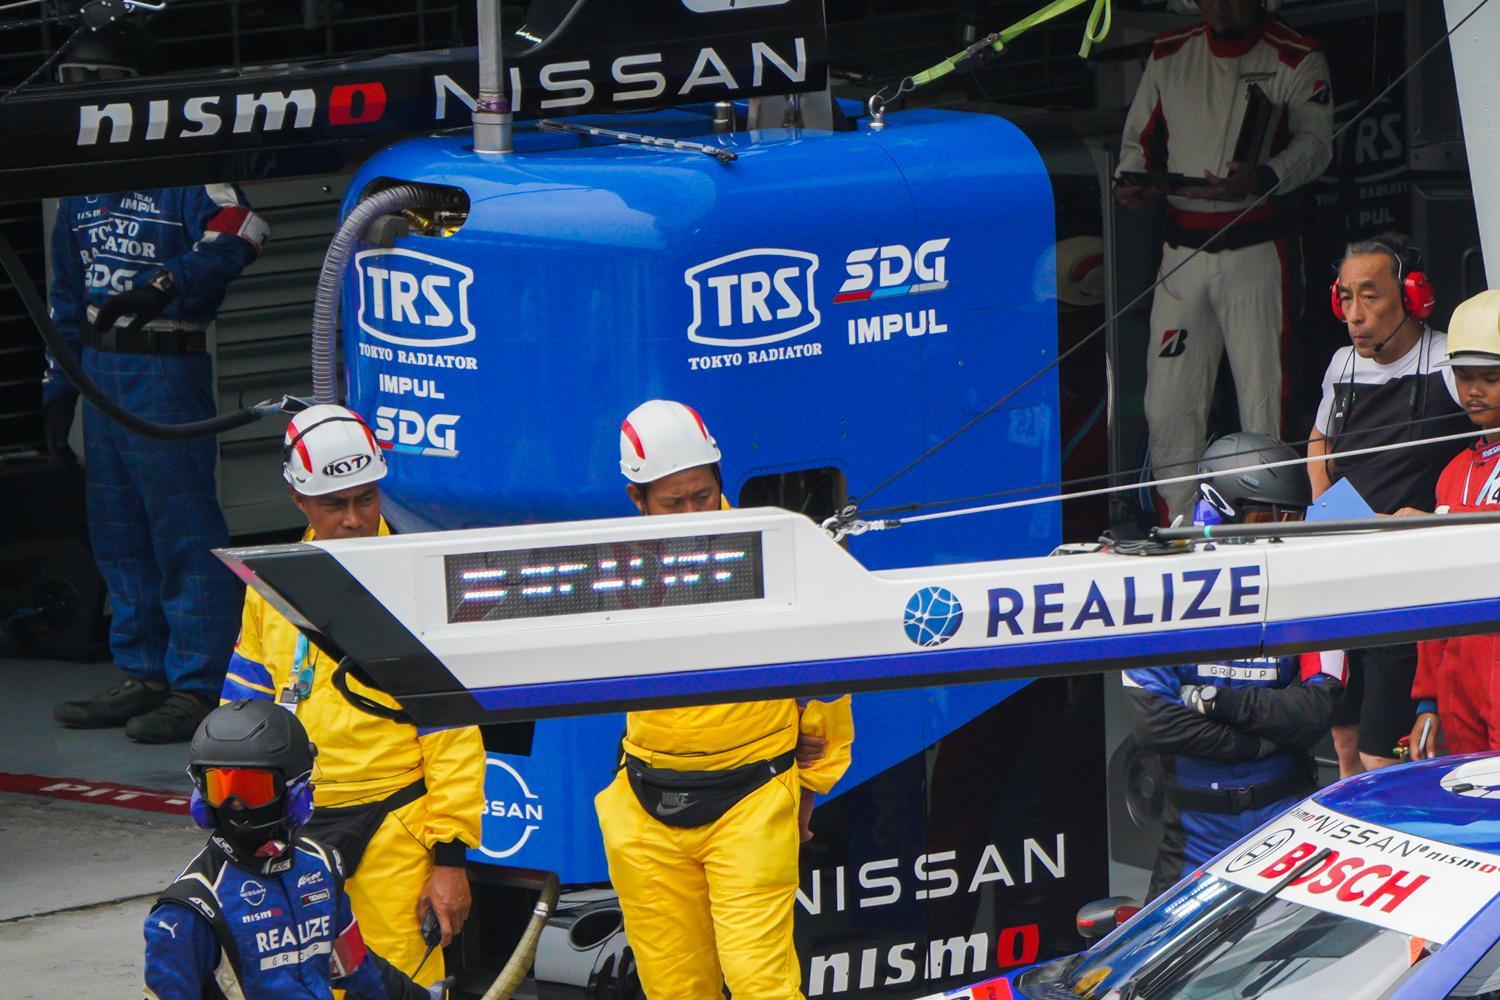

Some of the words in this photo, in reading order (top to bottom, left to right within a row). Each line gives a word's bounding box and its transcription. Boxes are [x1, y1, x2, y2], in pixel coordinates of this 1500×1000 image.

[435, 37, 806, 120] NISSAN
[77, 82, 387, 146] nismo
[367, 266, 454, 328] TRS
[707, 266, 803, 328] TRS
[848, 308, 948, 345] IMPUL
[359, 342, 393, 362] TOKYO
[397, 349, 478, 371] RADIATOR
[688, 352, 742, 371] TOKYO
[747, 342, 823, 366] RADIATOR
[379, 373, 446, 400] IMPUL
[986, 564, 1262, 639] REALIZE
[1210, 666, 1267, 679] GROUP
[40, 783, 143, 802] PIT
[1314, 814, 1421, 859] NISSAN
[796, 833, 1066, 916] NISSAN
[1257, 842, 1431, 914] BOSCH
[255, 914, 331, 953] REALIZE
[808, 923, 1040, 997] nismo
